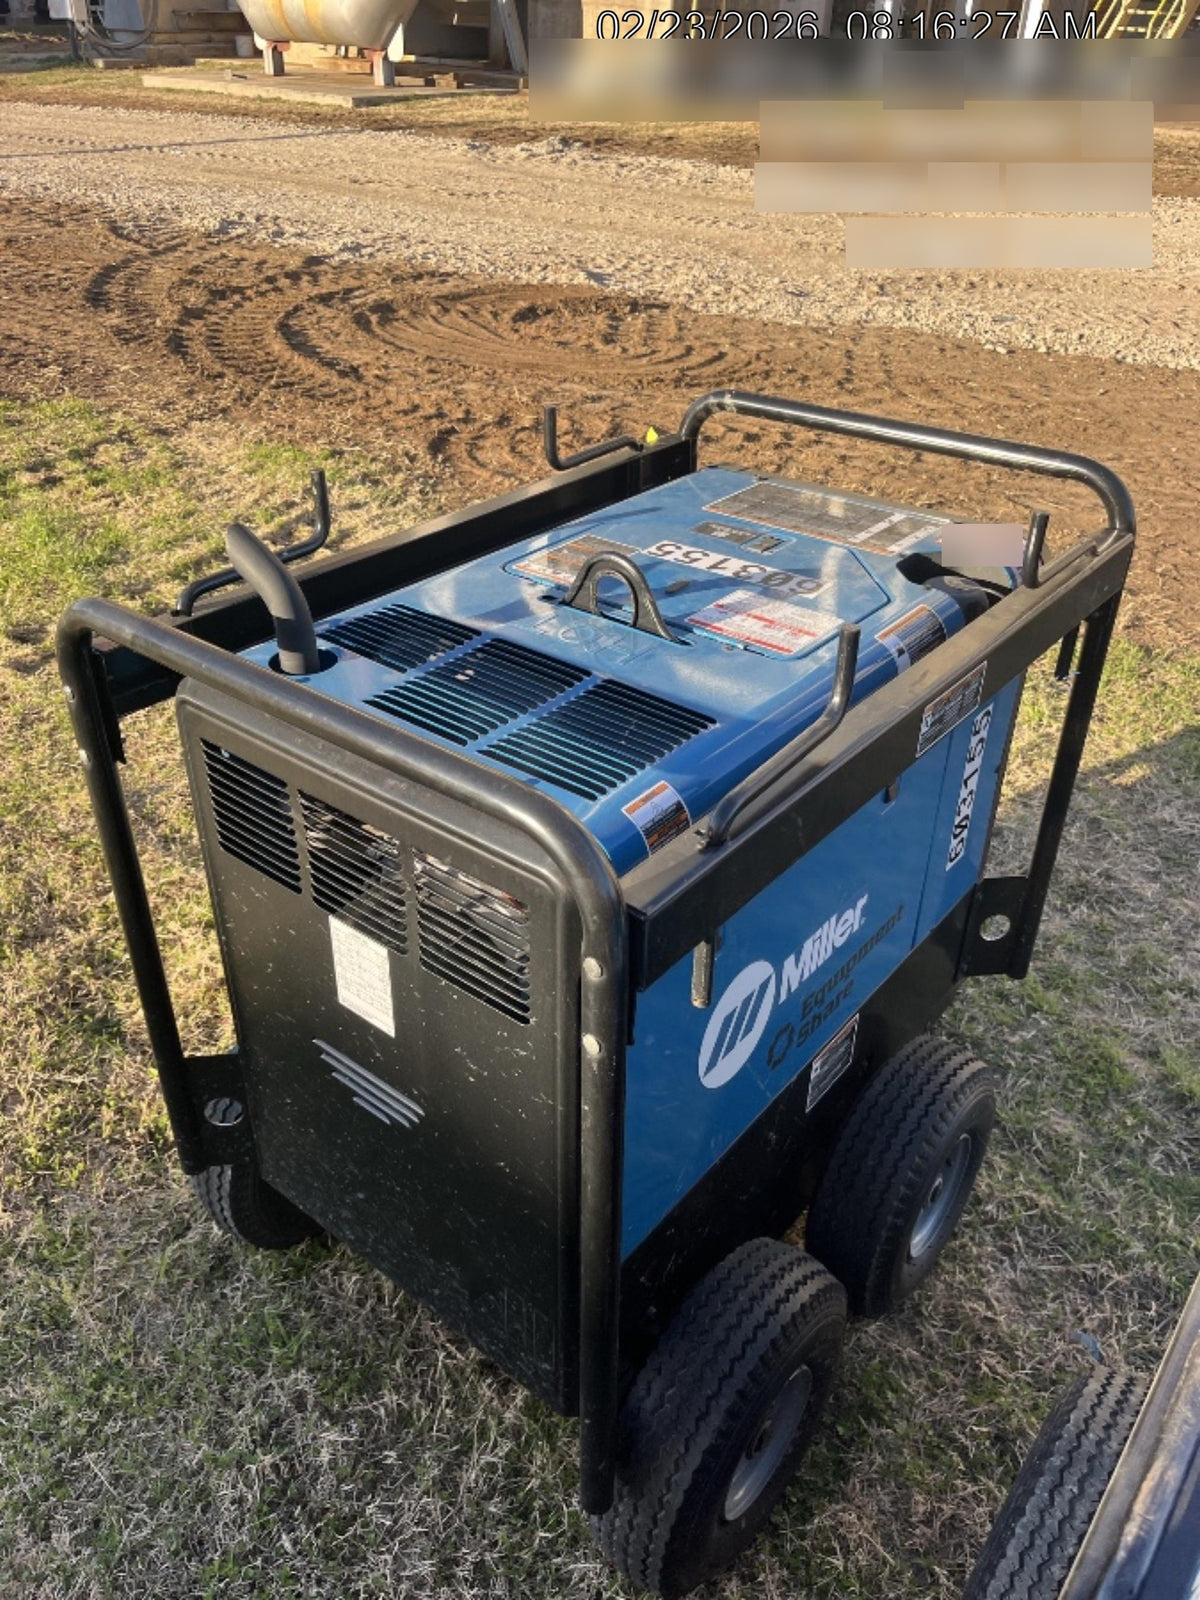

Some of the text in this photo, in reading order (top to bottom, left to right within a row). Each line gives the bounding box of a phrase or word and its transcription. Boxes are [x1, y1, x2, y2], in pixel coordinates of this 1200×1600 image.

[651, 543, 821, 596] 603155
[778, 893, 868, 1004] Miller
[802, 904, 903, 1019] Equipment
